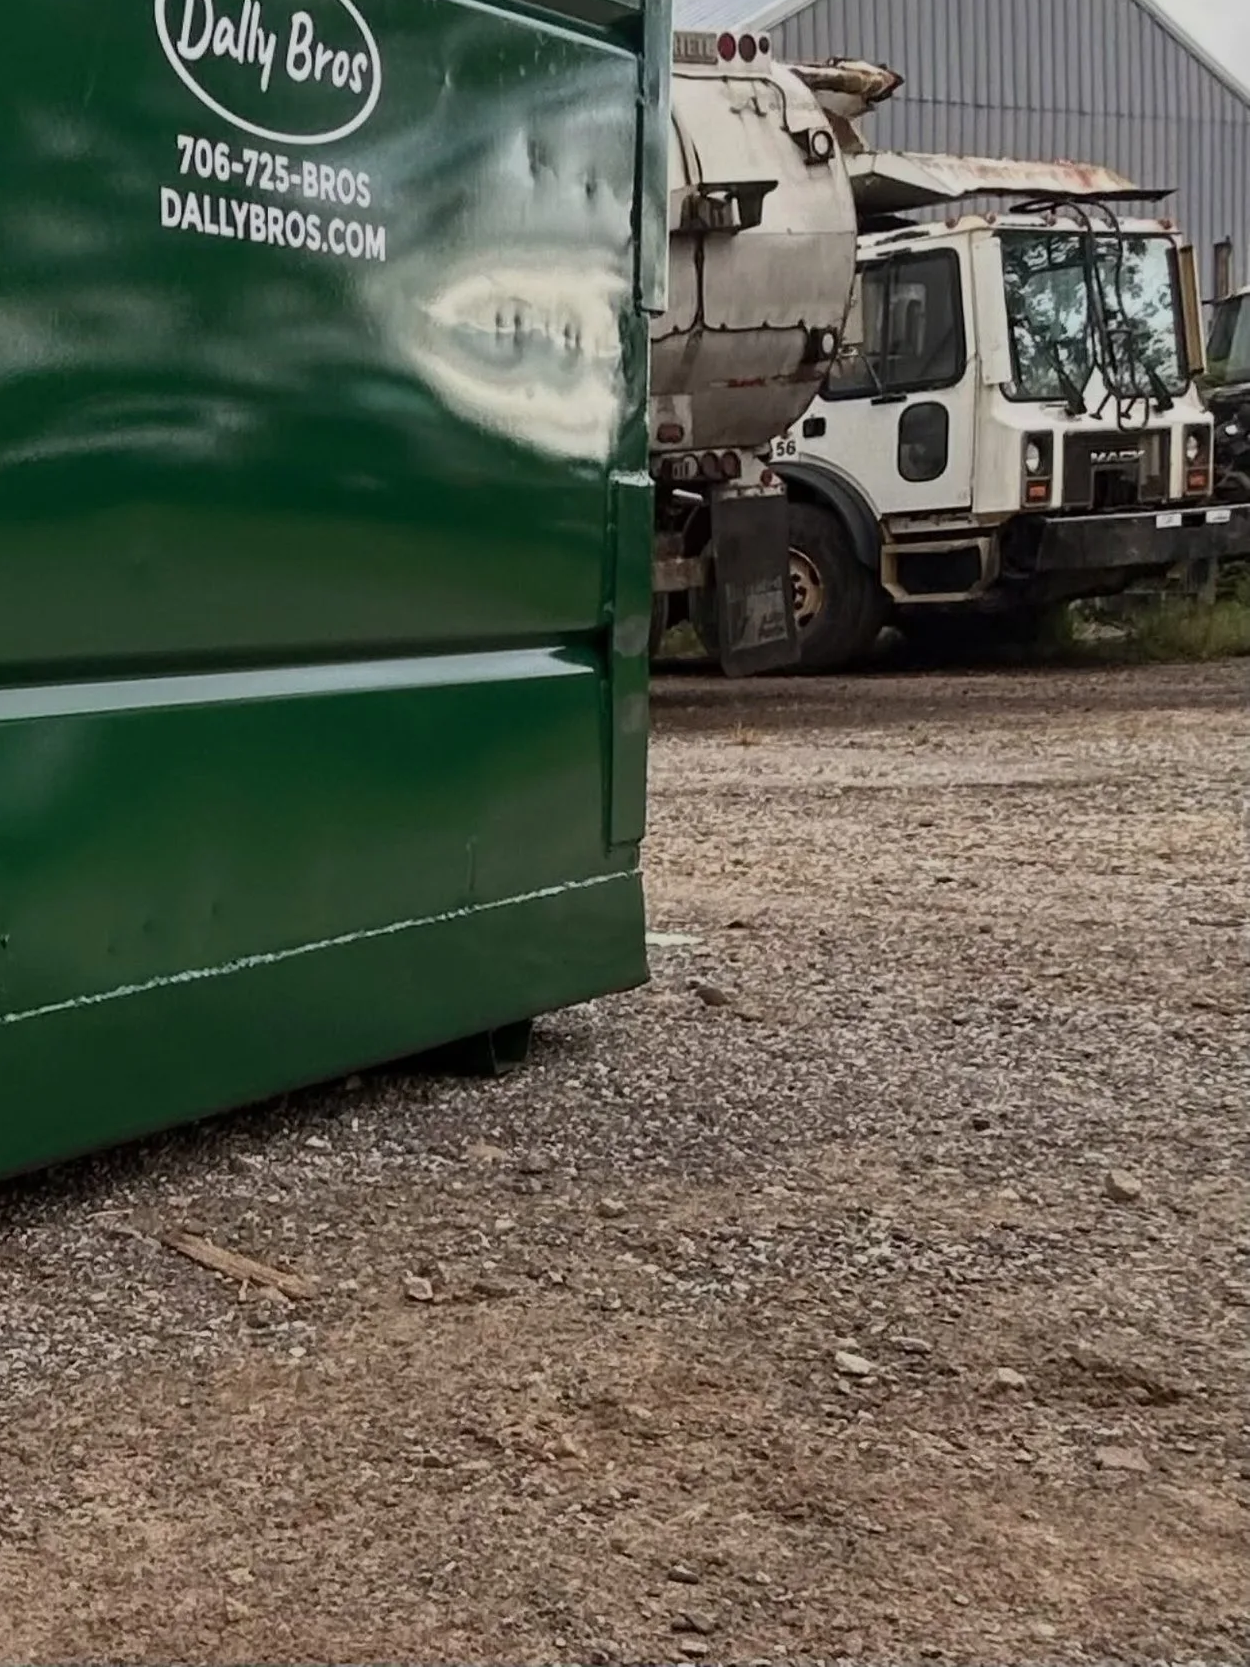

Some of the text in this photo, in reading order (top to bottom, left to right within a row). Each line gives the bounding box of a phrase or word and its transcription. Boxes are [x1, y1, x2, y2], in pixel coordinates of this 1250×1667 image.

[286, 11, 369, 94] Bros
[177, 134, 372, 208] 706-725-BROS
[160, 187, 387, 262] DALLYBROS.COM
[776, 440, 796, 457] 56
